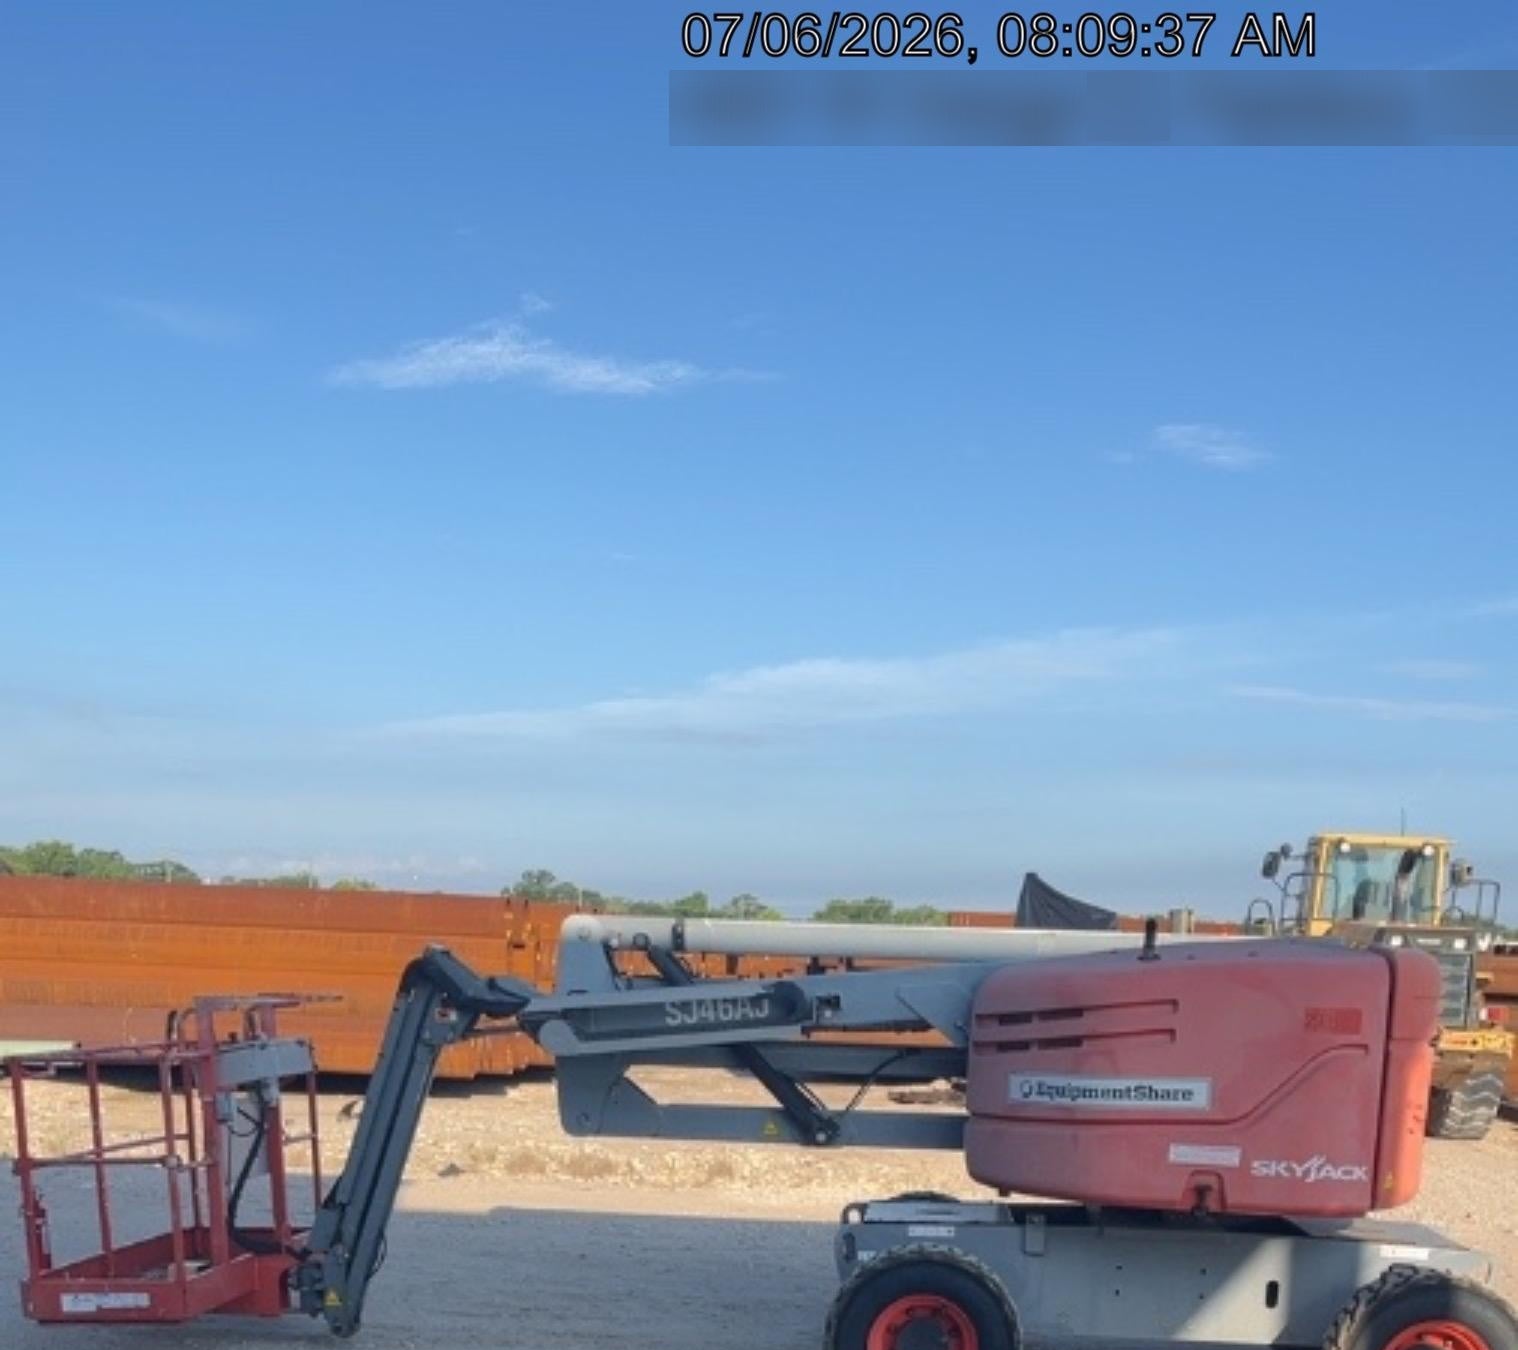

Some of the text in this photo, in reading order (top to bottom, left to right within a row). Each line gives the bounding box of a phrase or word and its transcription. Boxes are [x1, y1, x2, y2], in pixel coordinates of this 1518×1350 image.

[664, 998, 769, 1026] SJ46AJ
[1036, 1081, 1194, 1101] EquipmentShare
[1251, 1154, 1369, 1182] SKYJACK
